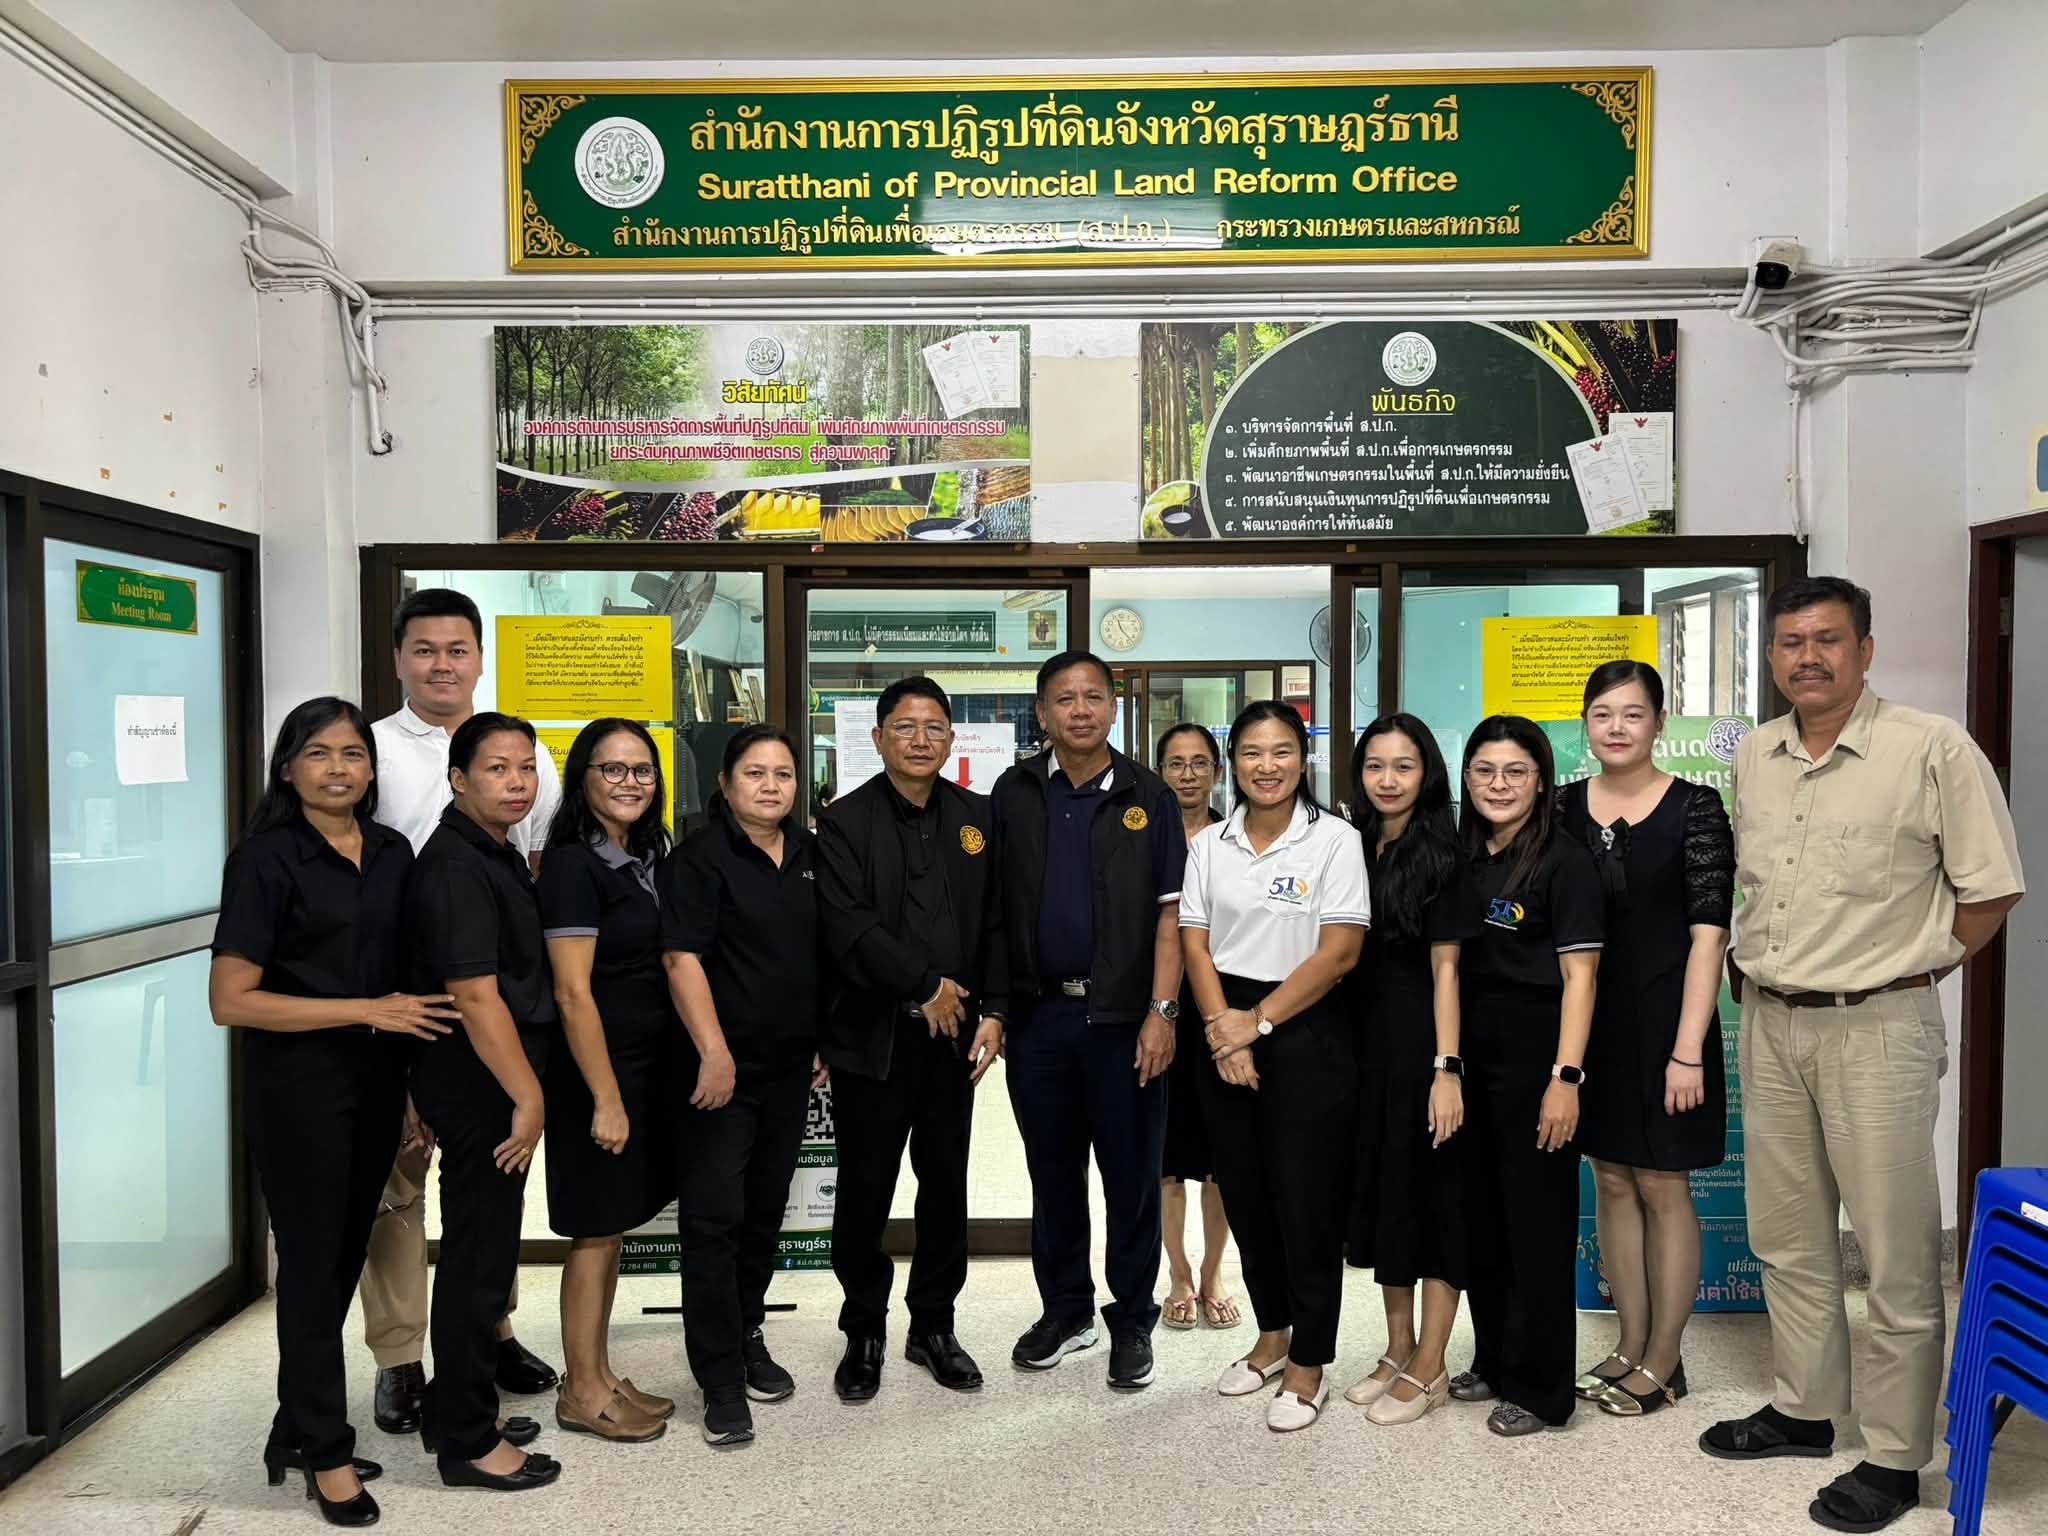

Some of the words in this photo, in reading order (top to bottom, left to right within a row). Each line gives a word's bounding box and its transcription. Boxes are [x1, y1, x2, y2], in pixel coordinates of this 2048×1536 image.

[690, 92, 1460, 164] สำนักงานการปฏิรูปที่ดินจังหวัดสุราษฎร์ธานี
[697, 172, 871, 201] Suratthani
[884, 171, 919, 199] of
[935, 169, 1097, 199] Provincial
[1113, 168, 1195, 197] Land
[1213, 166, 1338, 195] Reform
[1351, 164, 1459, 193] Office
[612, 204, 1062, 254] สำนักงานการปฏิรูปที่ดินเพื่อเกษตรกรรม
[1077, 216, 1172, 247] (ส.ป.ก.)
[1216, 204, 1521, 241] กระทรวงเกษตรและสหกรณ์
[721, 379, 808, 404] วิสัยทัศน์
[1371, 387, 1456, 413] พันธกิจ
[1225, 424, 1238, 434] ๑.
[1241, 410, 1354, 434] บริหารจัดการพื้นที่
[1359, 418, 1398, 433] ส.ป.ก.
[610, 443, 802, 464] ยกระดับคุณภาพชีวิตเกษตรกร
[1225, 446, 1238, 459] ๒.
[1242, 435, 1350, 458] เพิ่มศักยภาพพื้นที่
[1356, 435, 1513, 458] ส.ป.ก.เพื่อการเกษตรกรรม
[1241, 459, 1434, 483] พัฒนาอาชีพเกษตรกรรมในพื้นที่
[1440, 458, 1571, 482] ส.ป.ก.ให้มีความยั่งยืน
[1242, 484, 1550, 513] การสนับสนุนเงินทุนการปฏิรูปที่ดินเพื่อเกษตรกรรม
[1241, 513, 1395, 532] พัฒนาองค์การให้ทันสมัย
[111, 602, 146, 622] Meeting
[148, 607, 172, 623] Room
